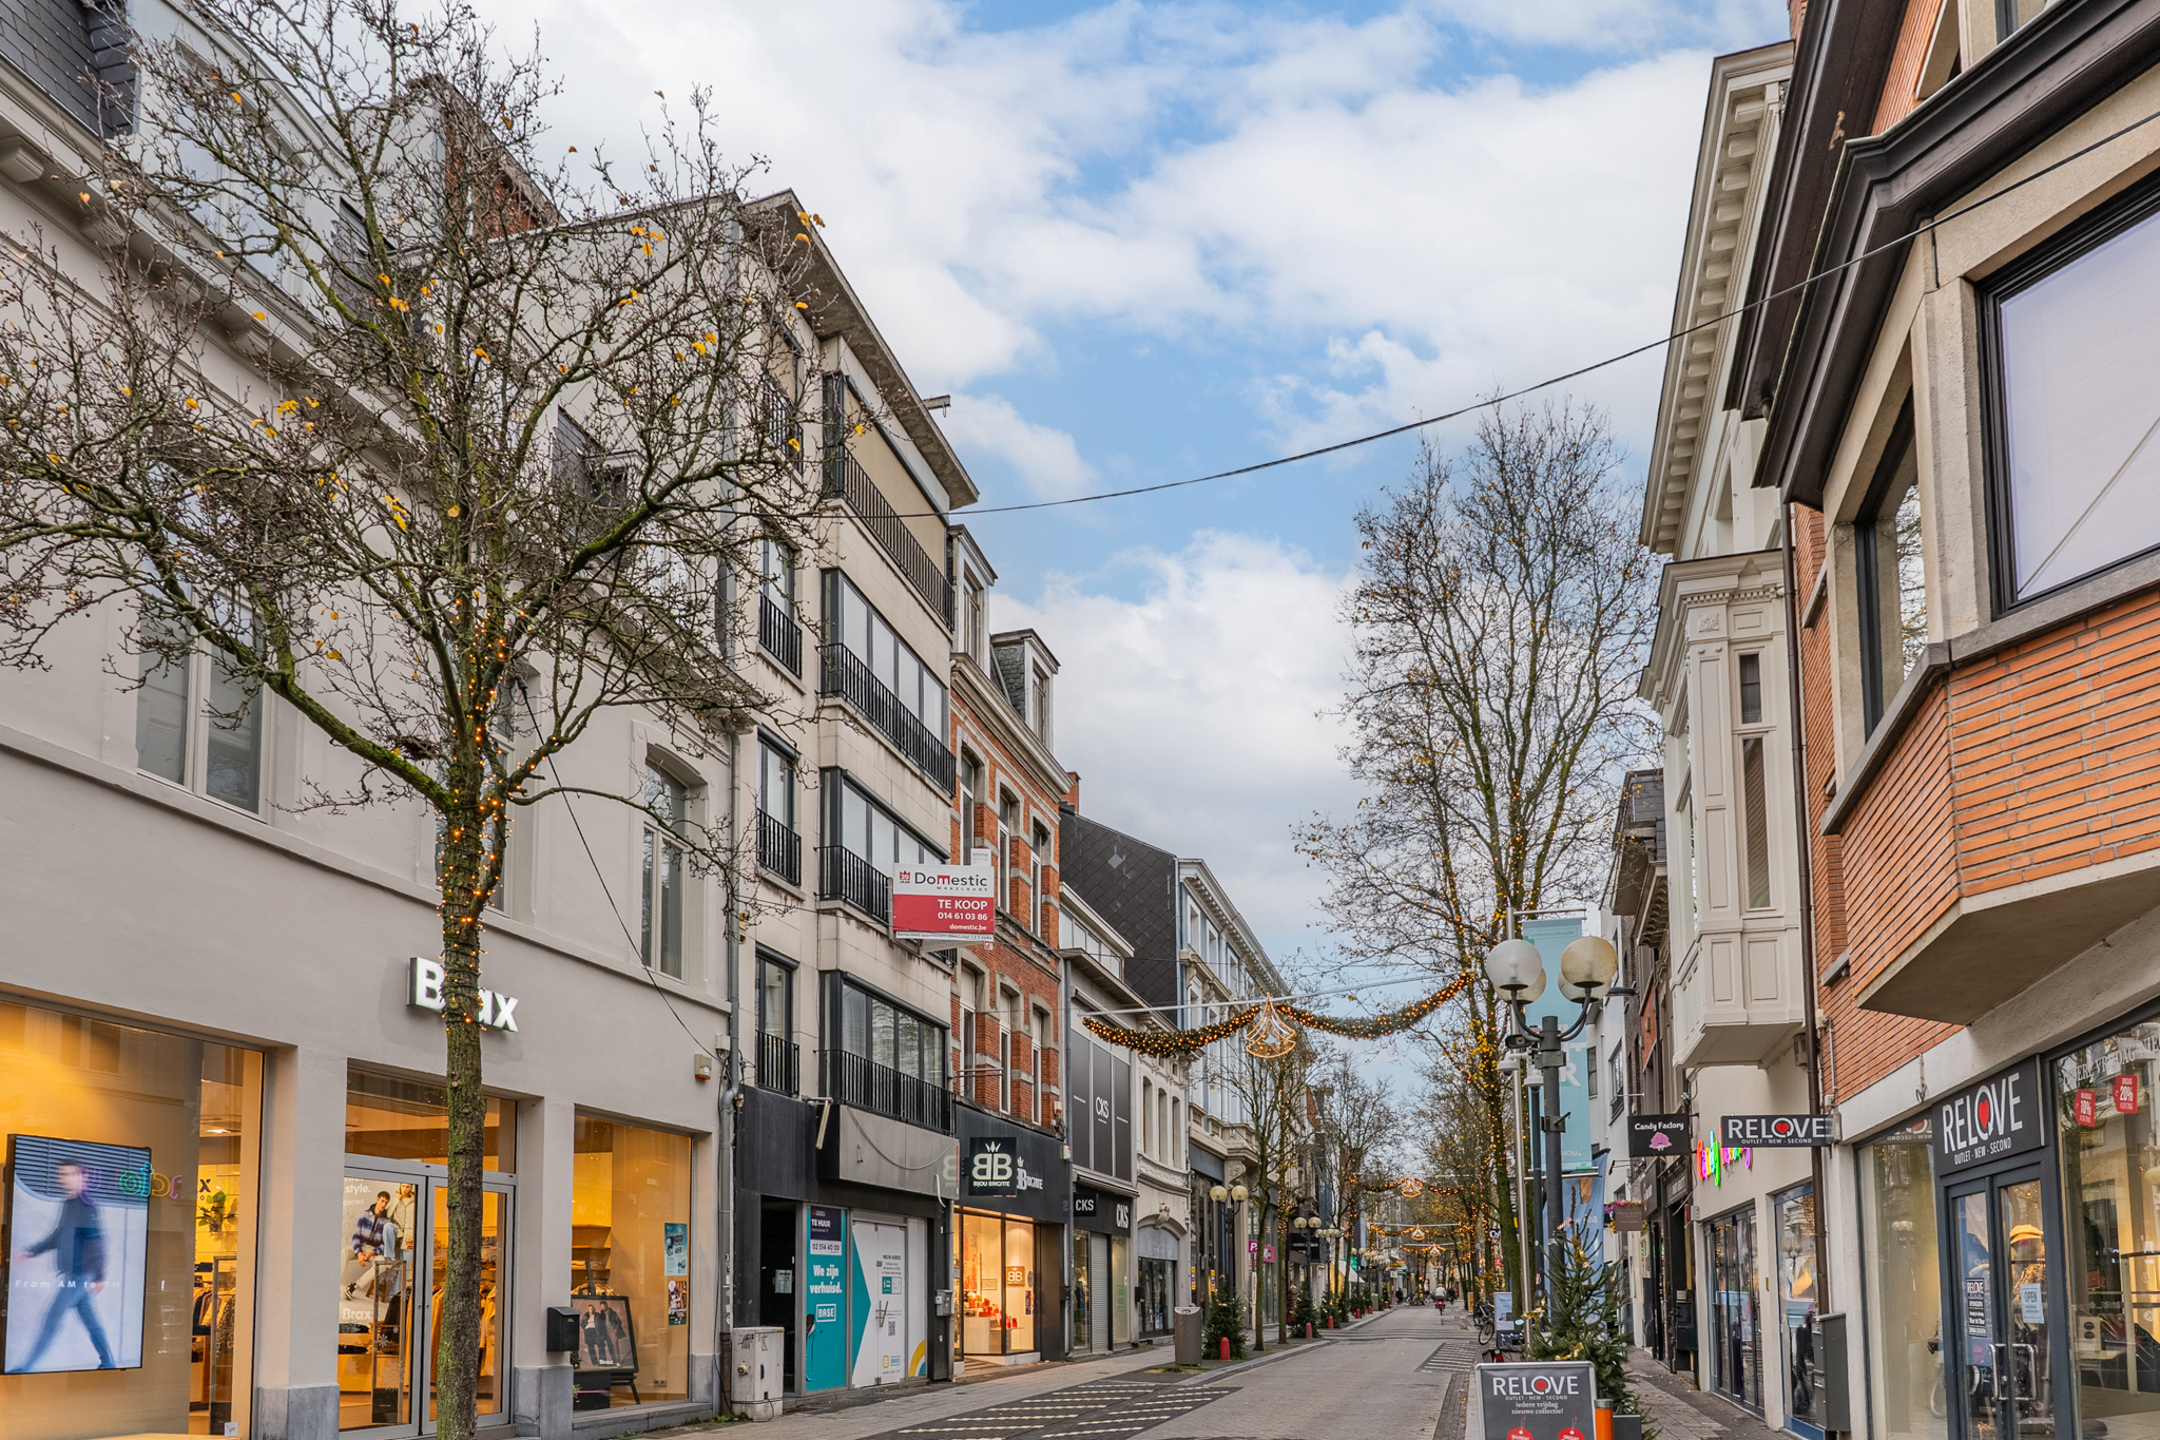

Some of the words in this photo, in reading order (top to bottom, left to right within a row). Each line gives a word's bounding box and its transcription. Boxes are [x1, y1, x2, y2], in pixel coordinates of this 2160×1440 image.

[915, 872, 987, 887] Domestic
[938, 899, 952, 909] TE
[954, 900, 988, 910] KOOP
[937, 912, 952, 920] 014
[954, 912, 964, 920] 61
[965, 912, 976, 921] 03
[977, 913, 987, 921] 86
[949, 924, 987, 932] domestic.be
[411, 957, 519, 1032] Bax
[2120, 1086, 2133, 1102] 20%
[1096, 1097, 1109, 1119] CKS
[1942, 1072, 2023, 1154] RELOVE
[2080, 1100, 2092, 1116] 10%
[1634, 1122, 1657, 1132] Candy
[1658, 1121, 1684, 1131] Factory
[1728, 1118, 1826, 1139] RELOVE
[1954, 1150, 1971, 1166] OUTLET
[1974, 1145, 1986, 1159] NEW
[1990, 1137, 2012, 1155] SECOND
[346, 1184, 372, 1195] style.
[1075, 1199, 1095, 1211] CKS
[1116, 1203, 1129, 1229] CKS
[811, 1218, 818, 1226] TE
[818, 1219, 831, 1228] HUUR
[813, 1264, 825, 1277] We
[826, 1264, 839, 1280] zijn
[15, 1280, 50, 1288] From
[58, 1280, 77, 1288] AM
[84, 1280, 97, 1288] to
[809, 1281, 843, 1294] verhuisd.
[2024, 1291, 2038, 1303] OPEN
[342, 1307, 372, 1321] Brax
[818, 1307, 835, 1318] BASE
[1492, 1375, 1579, 1396] RELOVE
[1536, 1401, 1558, 1409] vrijdag
